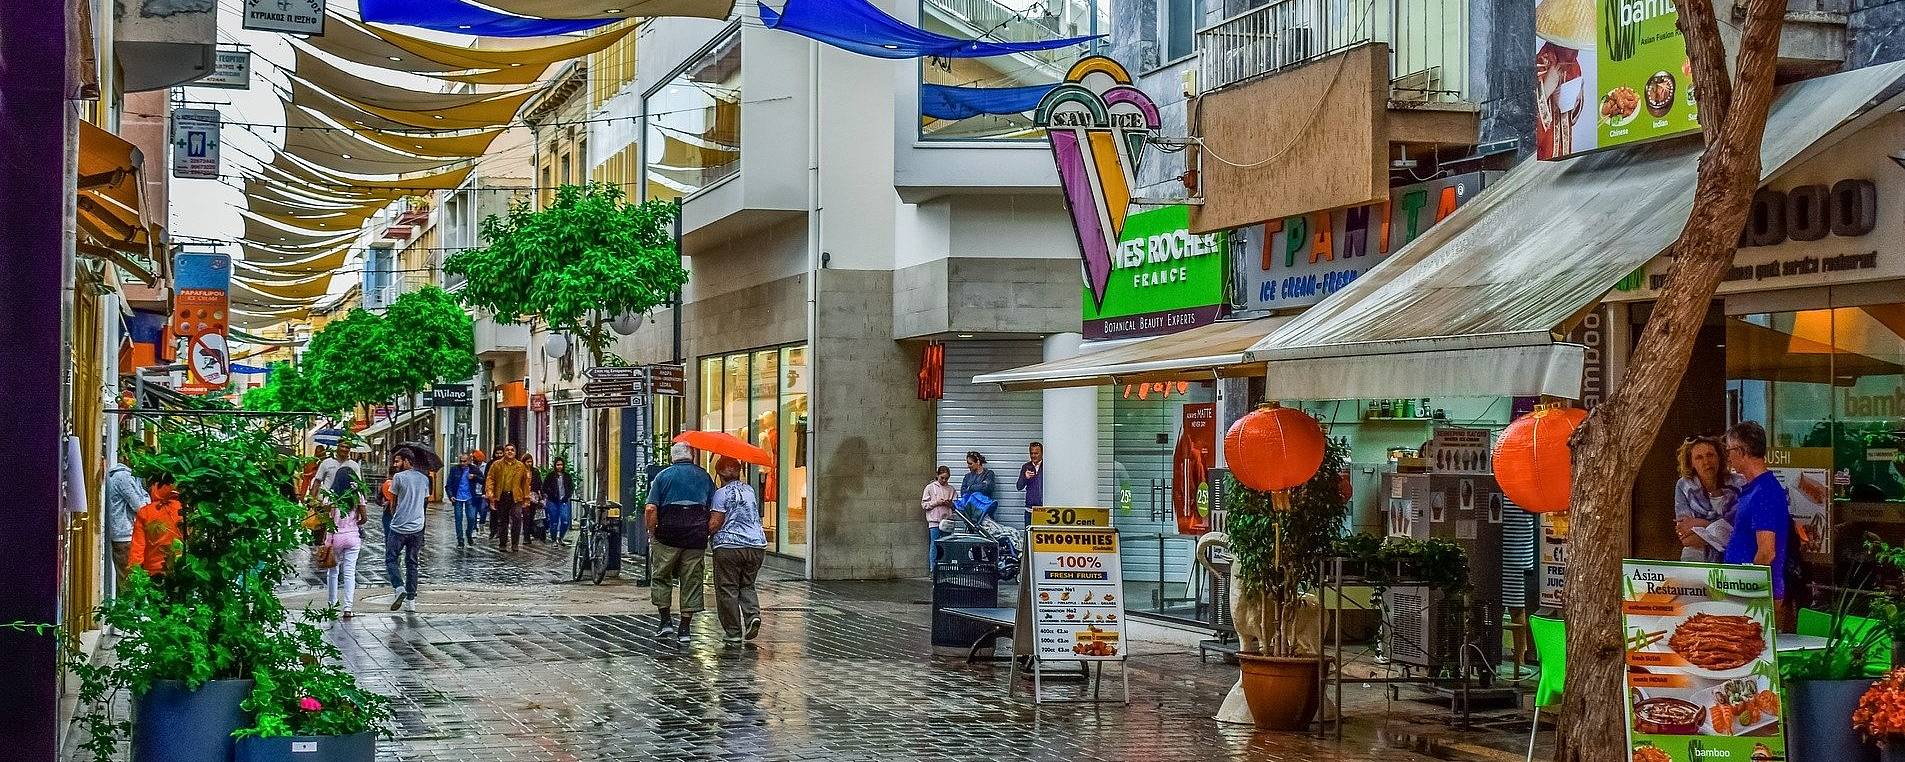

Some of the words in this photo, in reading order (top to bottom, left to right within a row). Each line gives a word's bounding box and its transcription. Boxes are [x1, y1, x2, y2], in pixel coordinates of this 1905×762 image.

[251, 11, 285, 22] ΚΥΡΙΑΚΟΣ
[1641, 36, 1655, 45] Asian
[1656, 31, 1674, 41] Fusion
[1652, 120, 1669, 128] Indian
[1609, 128, 1629, 137] Chinese
[1737, 179, 1877, 248] boo
[1115, 237, 1145, 269] VES
[1148, 228, 1219, 263] ROCHER
[1822, 251, 1878, 273] restaurant
[1133, 266, 1188, 288] FRANCE
[181, 289, 225, 297] PAPAFILIPOU
[1259, 280, 1277, 302] ICE
[1583, 313, 1600, 410] amboo
[433, 389, 466, 399] Milano
[1197, 407, 1213, 418] MATTE
[1046, 508, 1076, 525] 30
[1035, 533, 1113, 545] SMOOTHIES
[1057, 556, 1102, 568] 100%
[1076, 572, 1103, 580] FRUITS
[1632, 568, 1665, 582] Asian
[1546, 577, 1564, 588] JUIC
[1647, 581, 1708, 597] Restaurant
[1716, 577, 1760, 592] bamboo
[1695, 748, 1731, 758] bamboo
